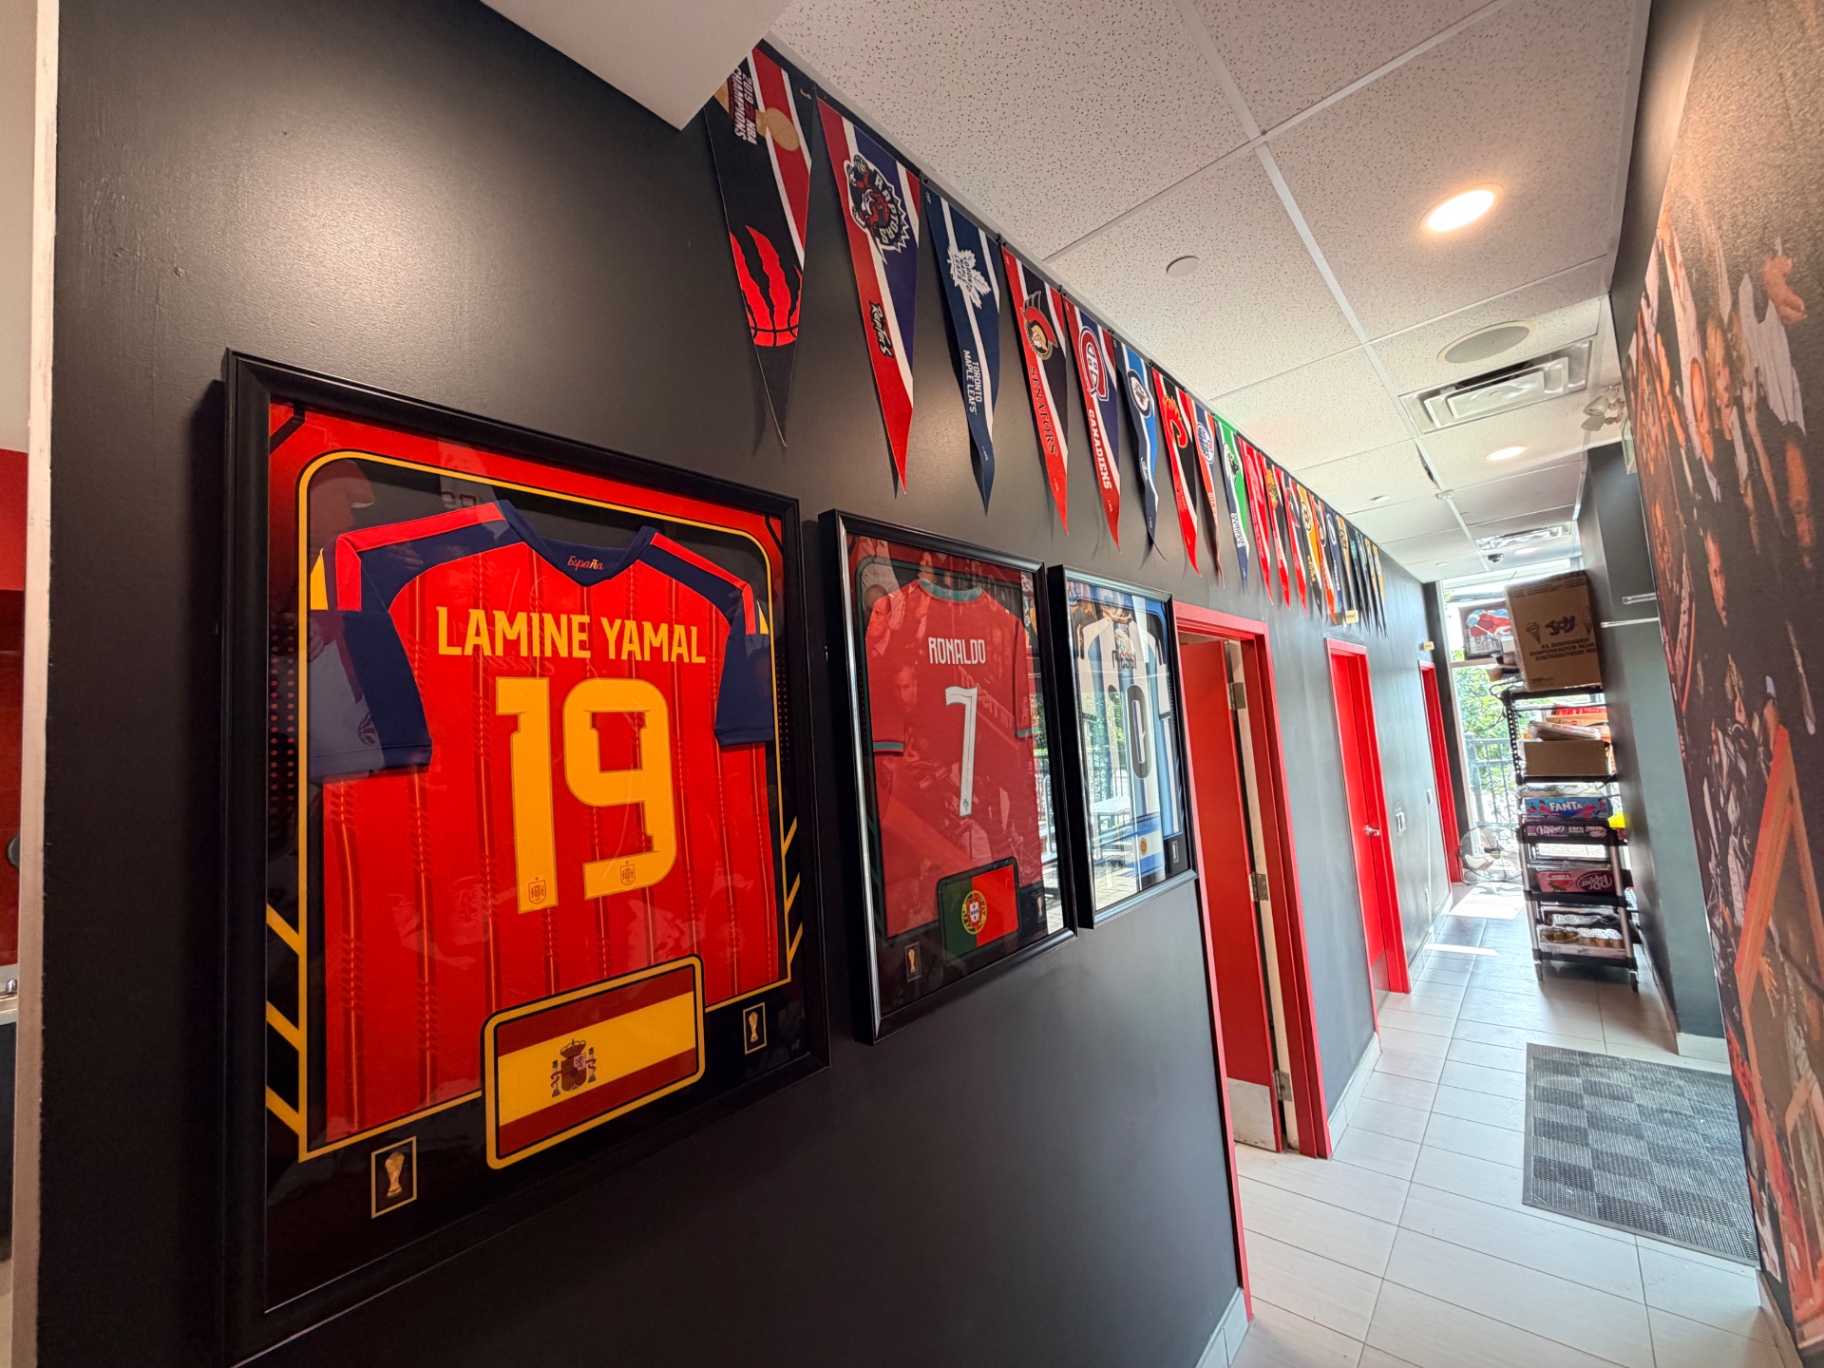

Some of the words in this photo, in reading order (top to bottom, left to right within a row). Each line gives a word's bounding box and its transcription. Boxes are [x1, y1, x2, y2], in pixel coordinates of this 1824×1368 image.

[732, 67, 747, 141] CHAMPIONS
[743, 73, 754, 105] 2019
[746, 118, 757, 145] NBA
[874, 174, 900, 244] RAPTORS
[963, 349, 973, 381] MAPLE
[973, 361, 983, 403] TORONTO
[966, 384, 977, 413] LEAFS
[1030, 366, 1056, 454] SENATORS
[1087, 409, 1112, 490] CANADIENS
[567, 555, 604, 571] España
[436, 606, 591, 658] LAMINE
[600, 616, 706, 664] YAMAL
[928, 637, 986, 665] RONALDO
[945, 686, 979, 817] 7
[495, 676, 677, 914] 19
